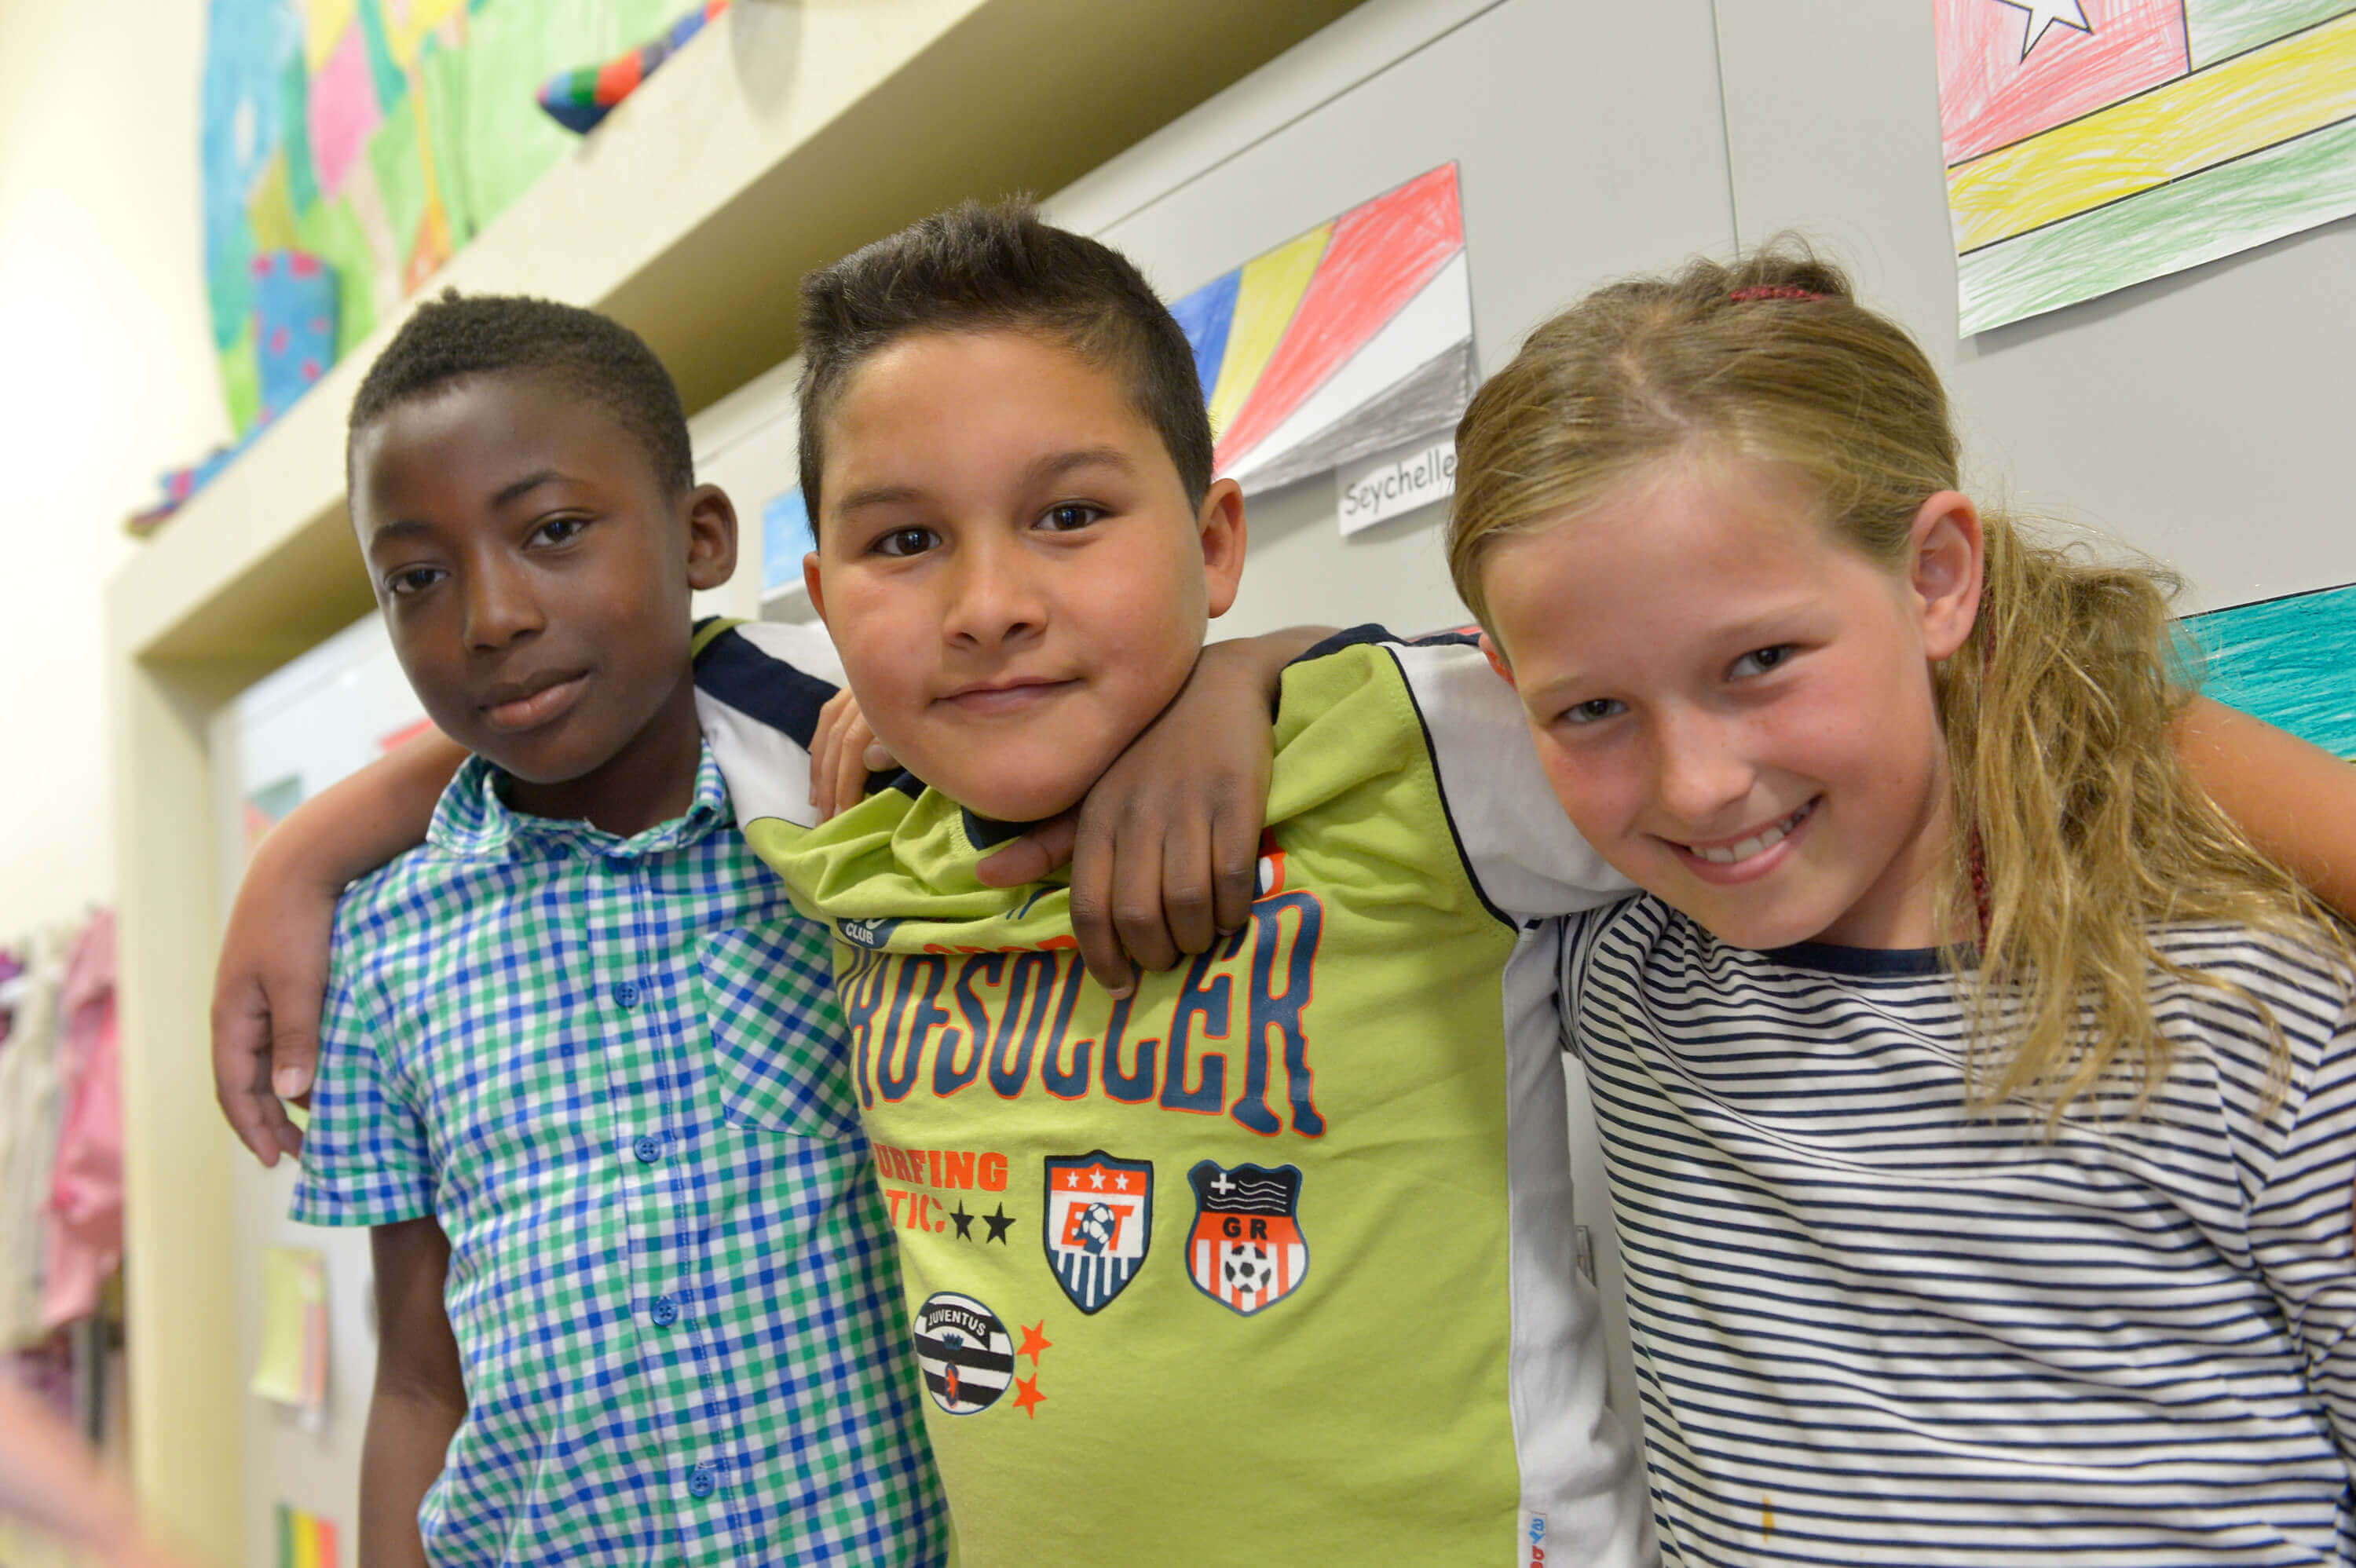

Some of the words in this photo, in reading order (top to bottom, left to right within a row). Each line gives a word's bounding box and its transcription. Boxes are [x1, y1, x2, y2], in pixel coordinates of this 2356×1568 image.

[1344, 446, 1456, 516] Seychelle
[845, 923, 874, 945] CLUB
[837, 889, 1327, 1138] ROSOCCER
[873, 1142, 1008, 1192] URFING
[927, 1309, 986, 1336] JUVENTUS
